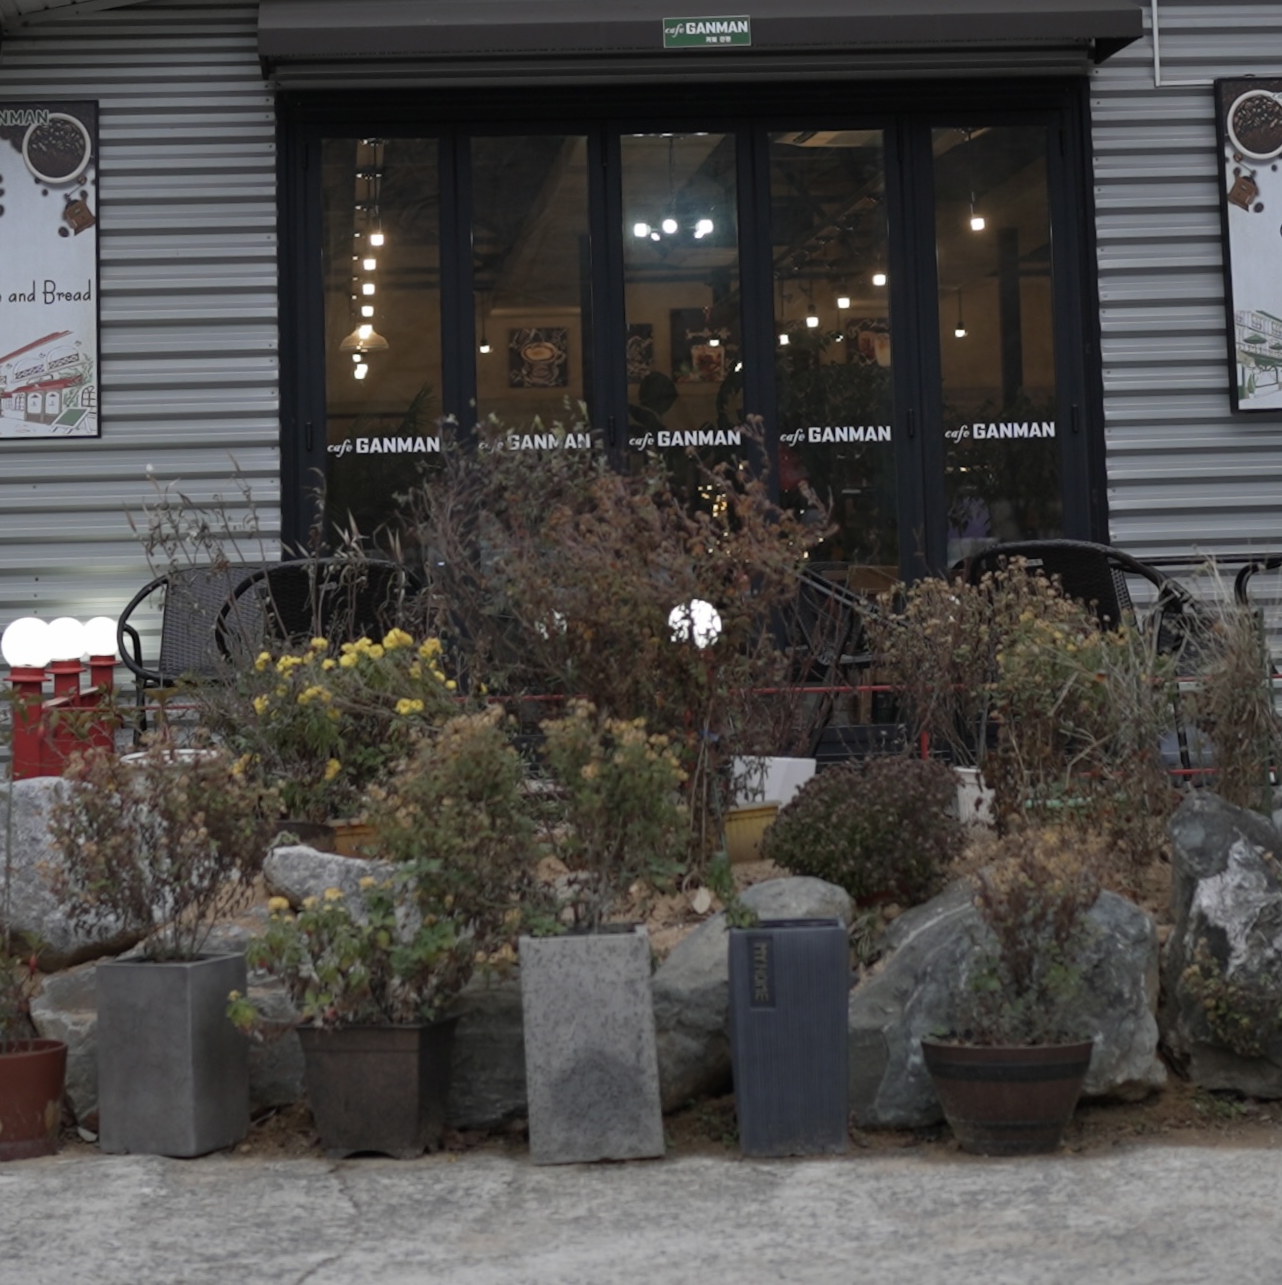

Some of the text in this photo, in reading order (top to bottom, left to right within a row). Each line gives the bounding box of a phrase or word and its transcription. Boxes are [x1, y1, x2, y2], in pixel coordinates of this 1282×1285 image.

[664, 20, 749, 38] cafe GANMAN
[8, 280, 36, 303] and
[42, 279, 92, 306] Bread
[629, 430, 742, 451] cafe GANMAN
[779, 425, 892, 446] cafe GANMAN
[944, 421, 1056, 443] cafe GANMAN
[327, 437, 441, 458] cafe GANMAN
